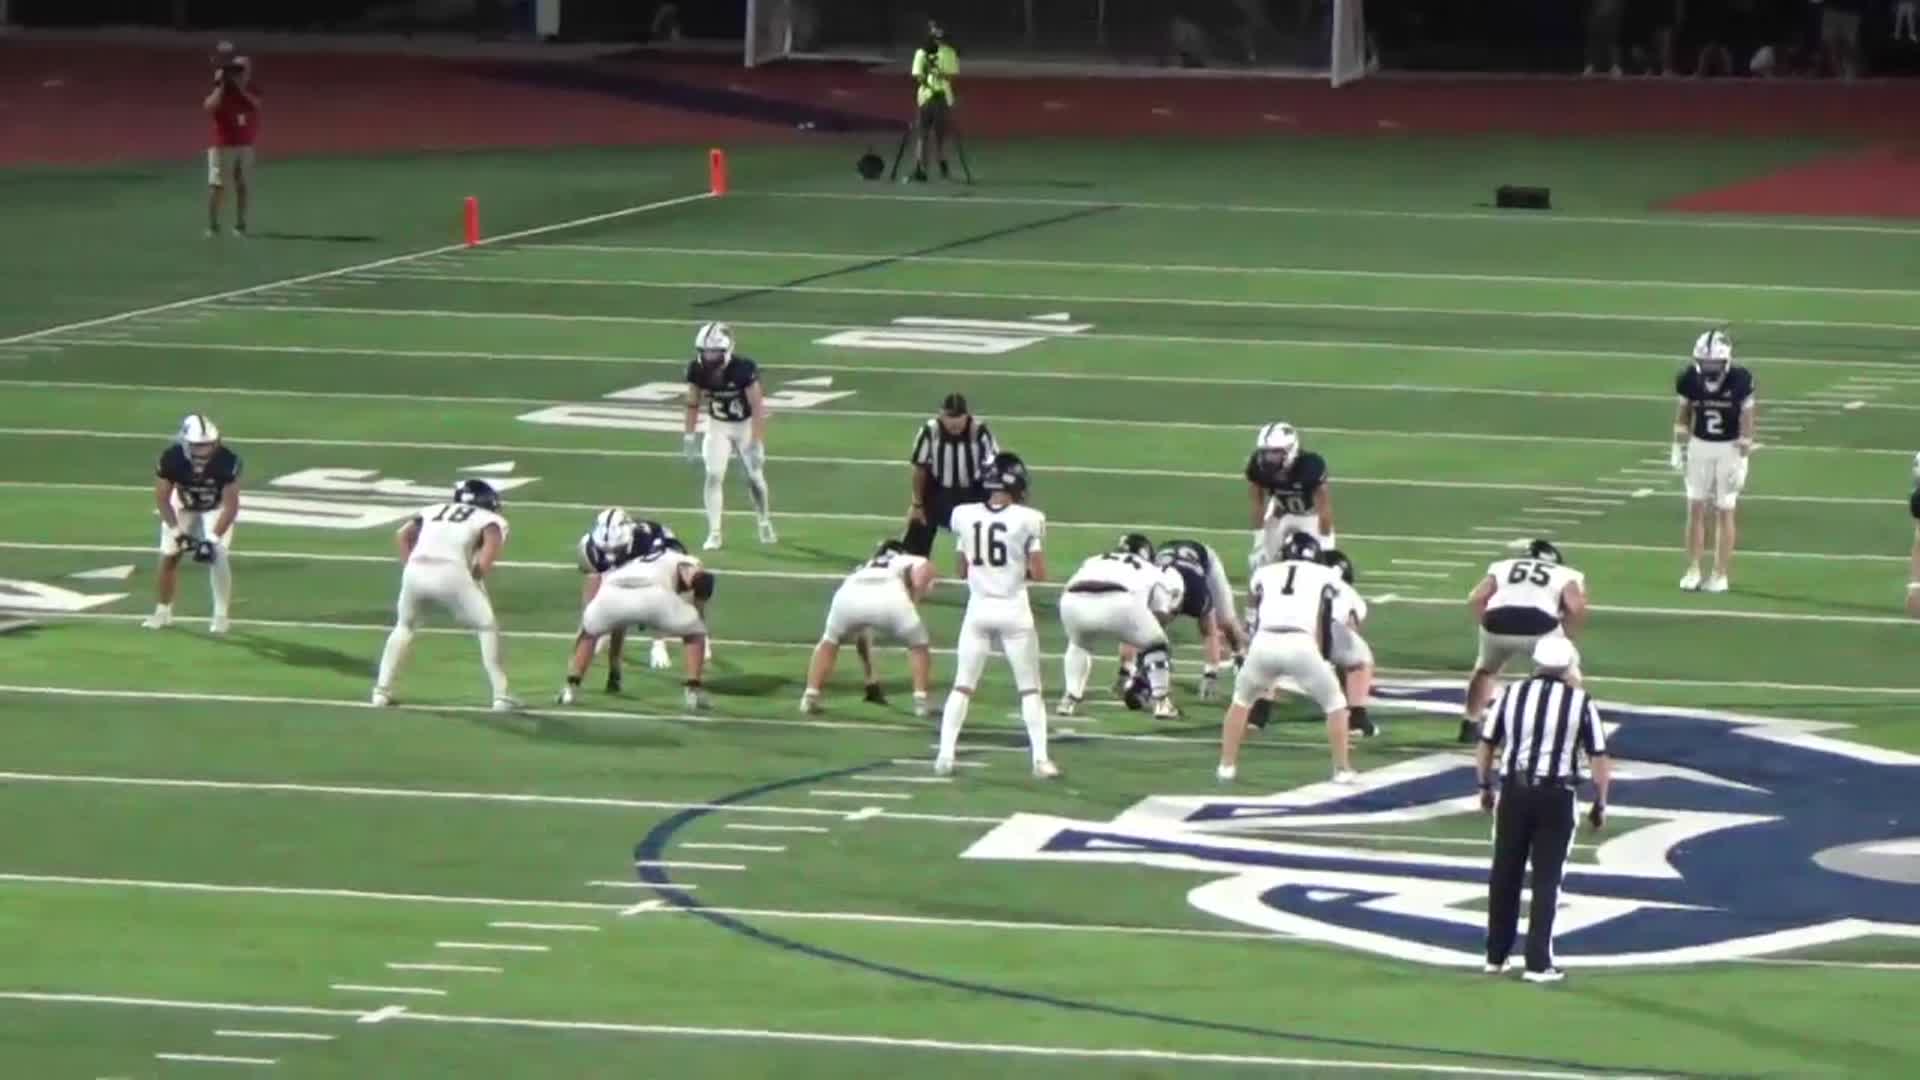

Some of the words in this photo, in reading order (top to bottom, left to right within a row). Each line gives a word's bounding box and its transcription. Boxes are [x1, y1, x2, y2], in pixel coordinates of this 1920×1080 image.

[1704, 410, 1723, 434] 2
[431, 504, 476, 523] 18
[973, 520, 1008, 567] 16
[1281, 565, 1297, 595] 1
[1508, 561, 1554, 587] 65
